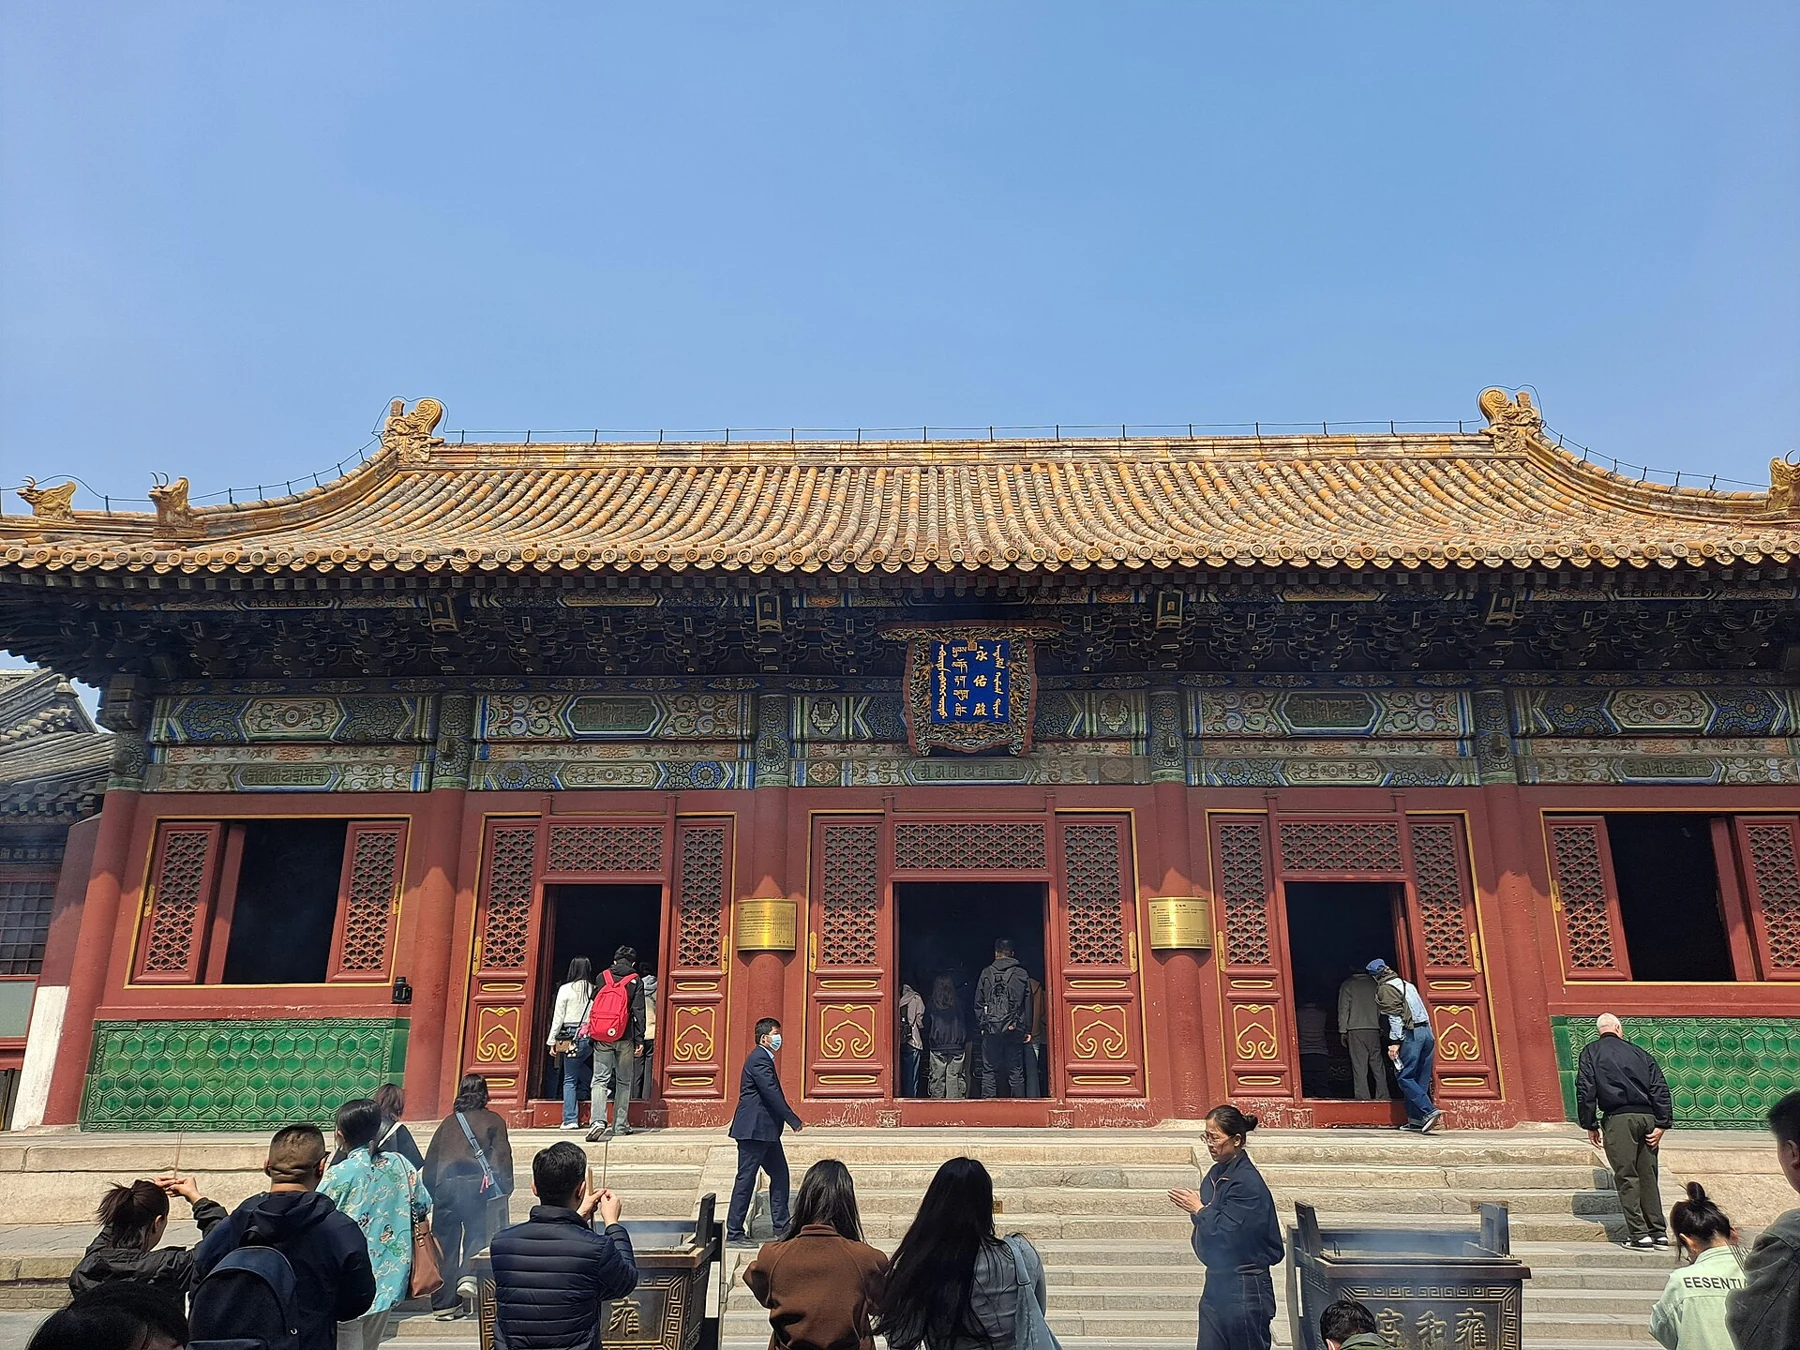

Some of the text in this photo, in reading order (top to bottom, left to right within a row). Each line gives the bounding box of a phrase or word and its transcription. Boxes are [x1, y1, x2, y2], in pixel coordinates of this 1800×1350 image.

[972, 645, 988, 716] 永佑殿
[608, 1297, 641, 1337] 雍
